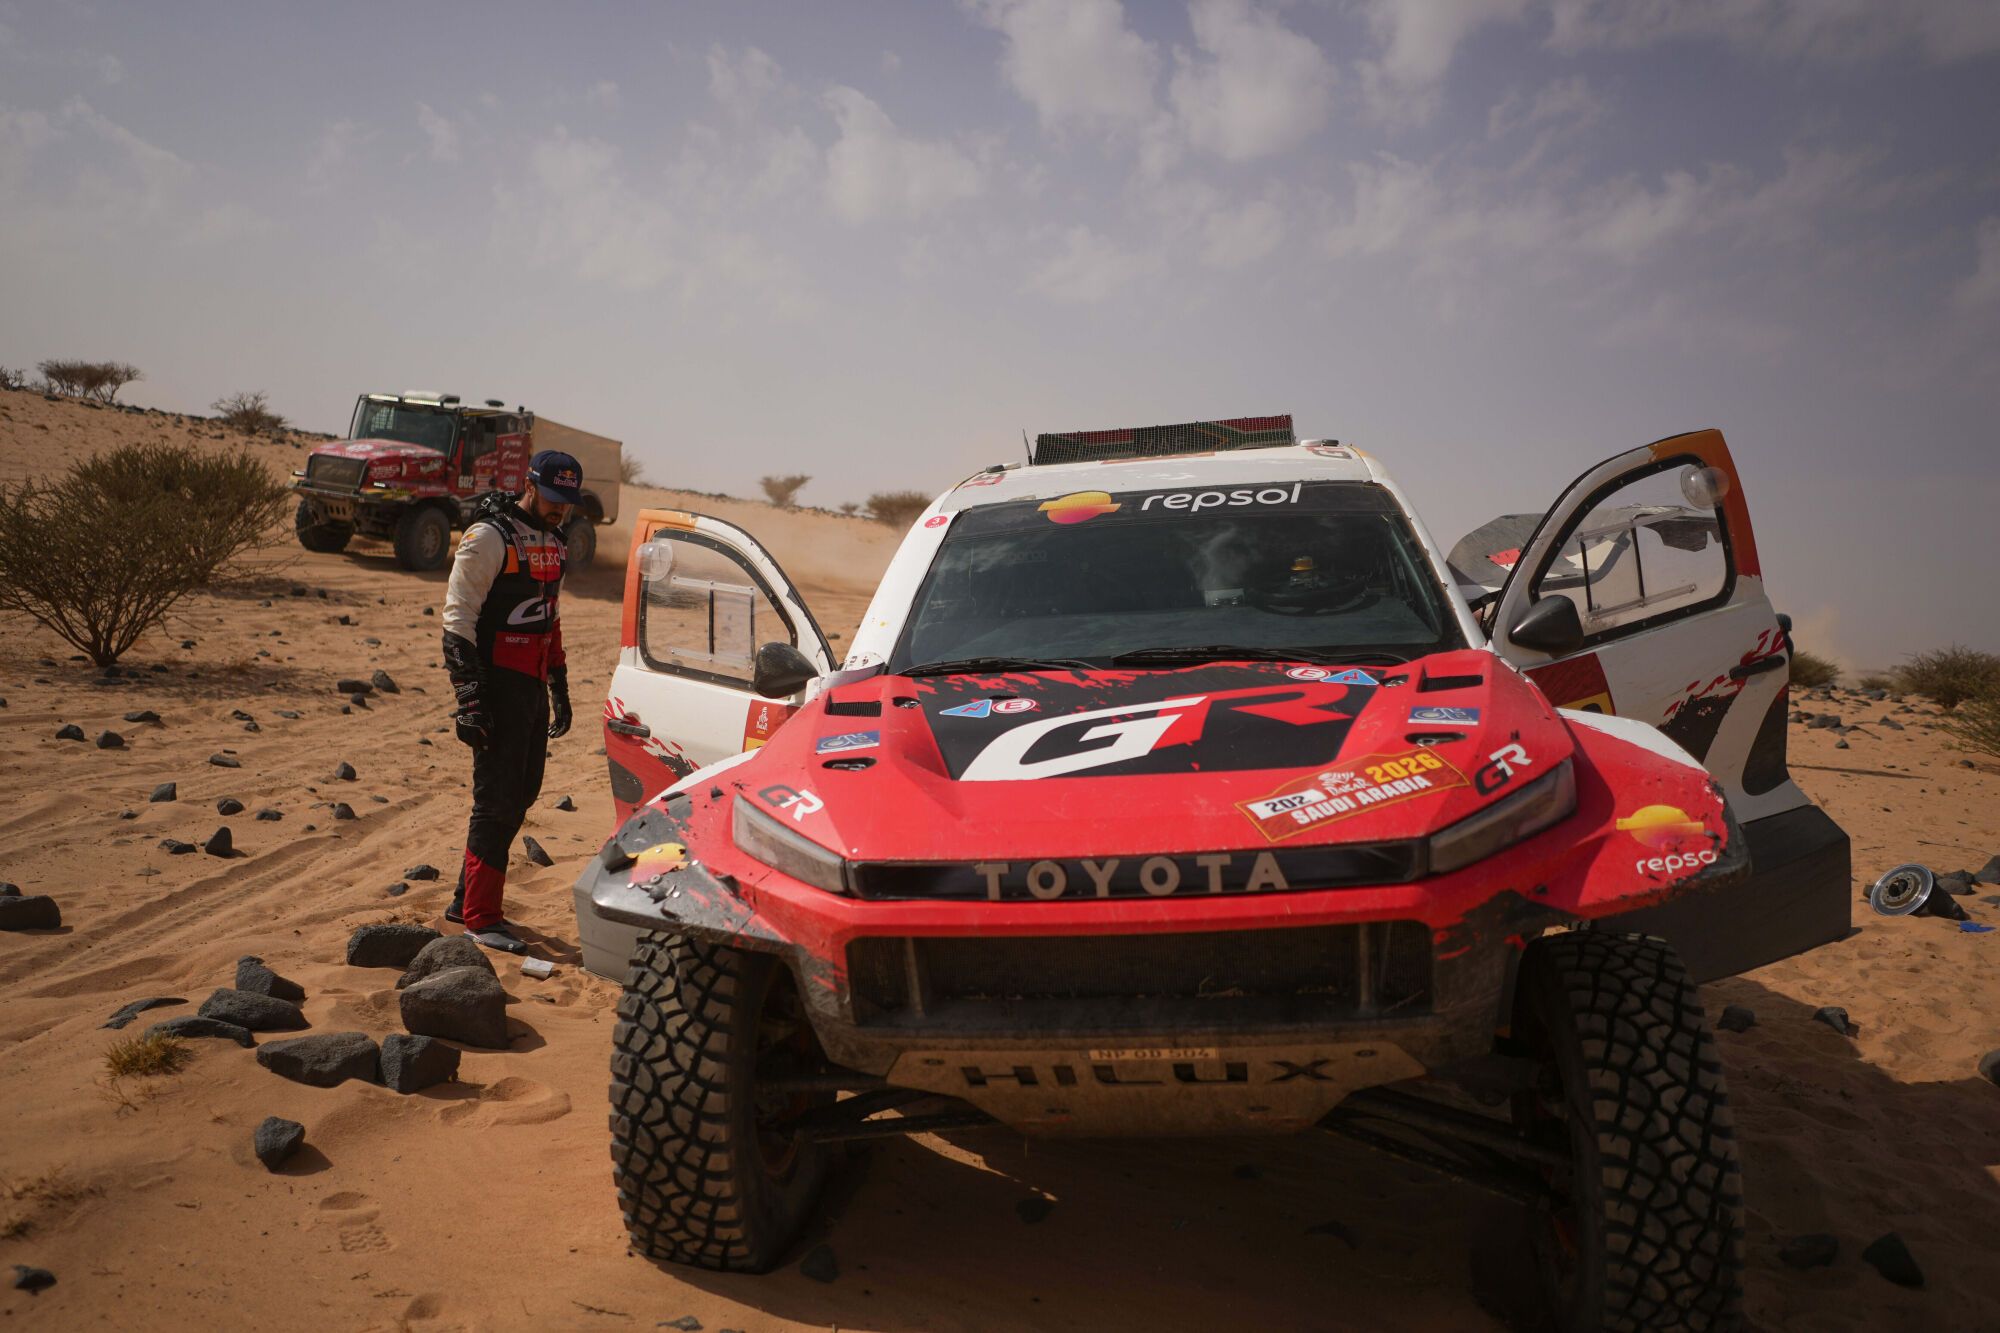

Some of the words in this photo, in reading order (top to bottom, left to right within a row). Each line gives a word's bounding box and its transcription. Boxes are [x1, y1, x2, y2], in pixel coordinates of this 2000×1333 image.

[458, 475, 475, 489] 602
[1141, 482, 1302, 513] repsol
[959, 683, 1354, 782] GR
[1365, 752, 1443, 785] 2026
[1474, 743, 1533, 797] GR
[758, 784, 825, 823] GR
[1264, 795, 1312, 814] 202
[1290, 796, 1357, 826] SAUDI
[1353, 774, 1433, 807] ARABIA
[975, 851, 1289, 901] TOYOTA
[1635, 850, 1718, 875] repso
[961, 1058, 1333, 1087] HILUX
